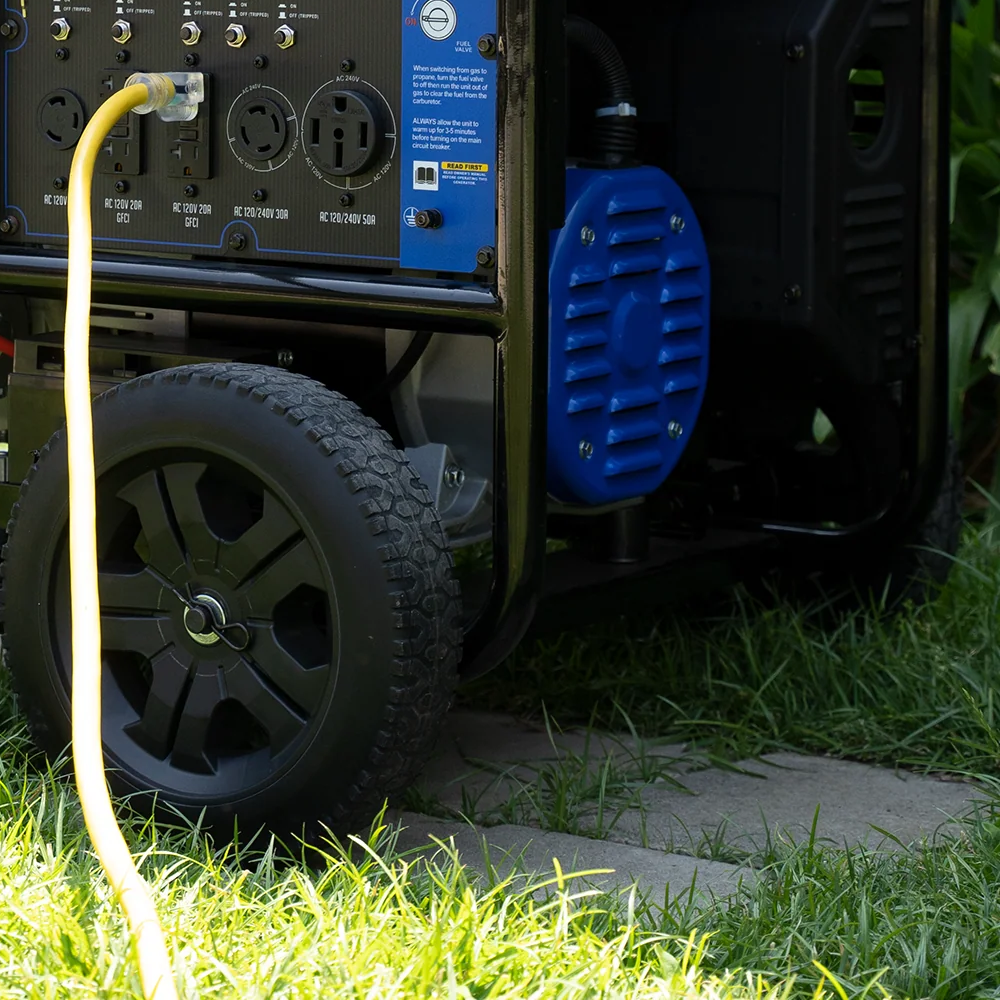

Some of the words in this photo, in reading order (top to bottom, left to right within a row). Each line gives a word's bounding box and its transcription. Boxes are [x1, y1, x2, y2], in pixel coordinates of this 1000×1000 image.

[405, 17, 417, 26] ON
[430, 135, 449, 143] turning
[305, 156, 314, 167] AC
[373, 174, 381, 182] AC
[380, 162, 392, 175] 120V
[44, 195, 52, 205] AC
[53, 195, 67, 206] 120V
[105, 198, 113, 209] AC
[114, 199, 128, 210] 120V
[130, 200, 142, 210] 20A
[173, 202, 182, 212] AC
[183, 203, 197, 214] 120V
[199, 204, 212, 215] 20A
[234, 206, 242, 216] AC
[244, 207, 274, 219] 120/240V
[276, 208, 288, 219] 30A
[116, 213, 130, 223] GFCI
[185, 217, 198, 228] GFCI
[320, 212, 328, 222] AC
[330, 212, 361, 224] 120/240V
[363, 214, 375, 225] 50A
